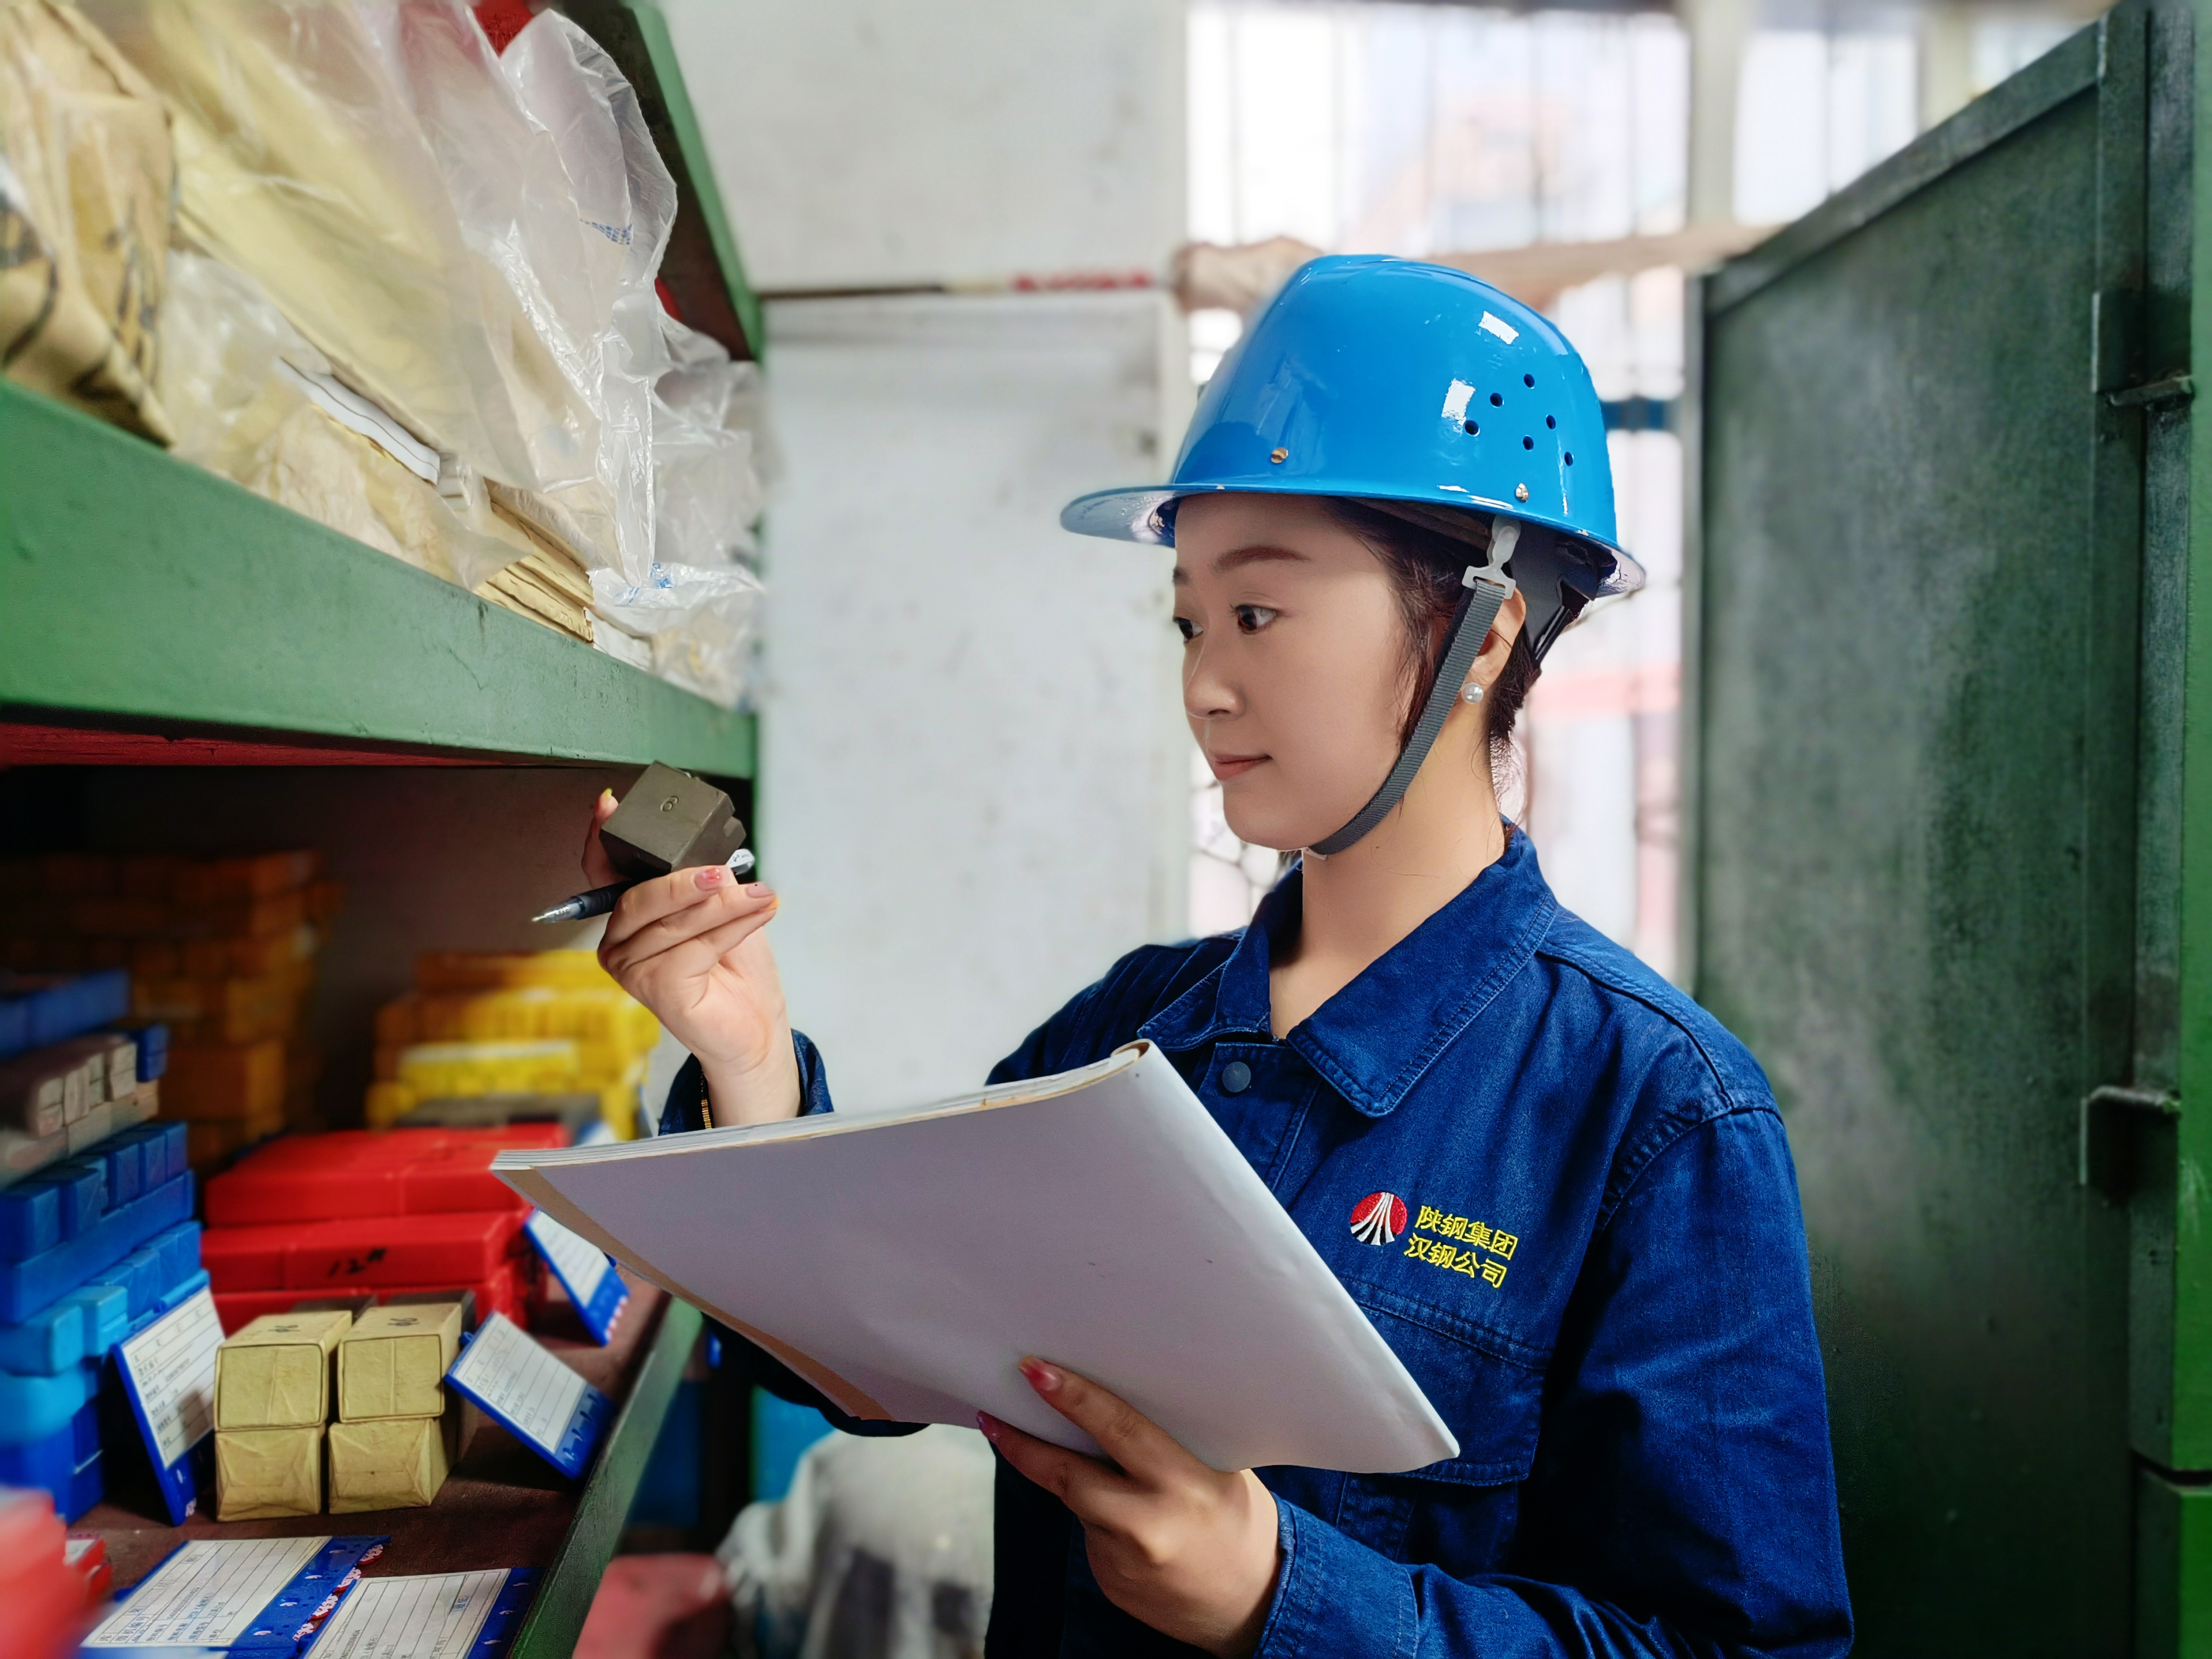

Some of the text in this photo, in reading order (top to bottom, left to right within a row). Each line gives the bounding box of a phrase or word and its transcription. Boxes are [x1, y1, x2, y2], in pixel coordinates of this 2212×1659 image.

[1404, 1232, 1508, 1289] 汉钢公司
[1414, 1205, 1519, 1260] 陕钢集团
